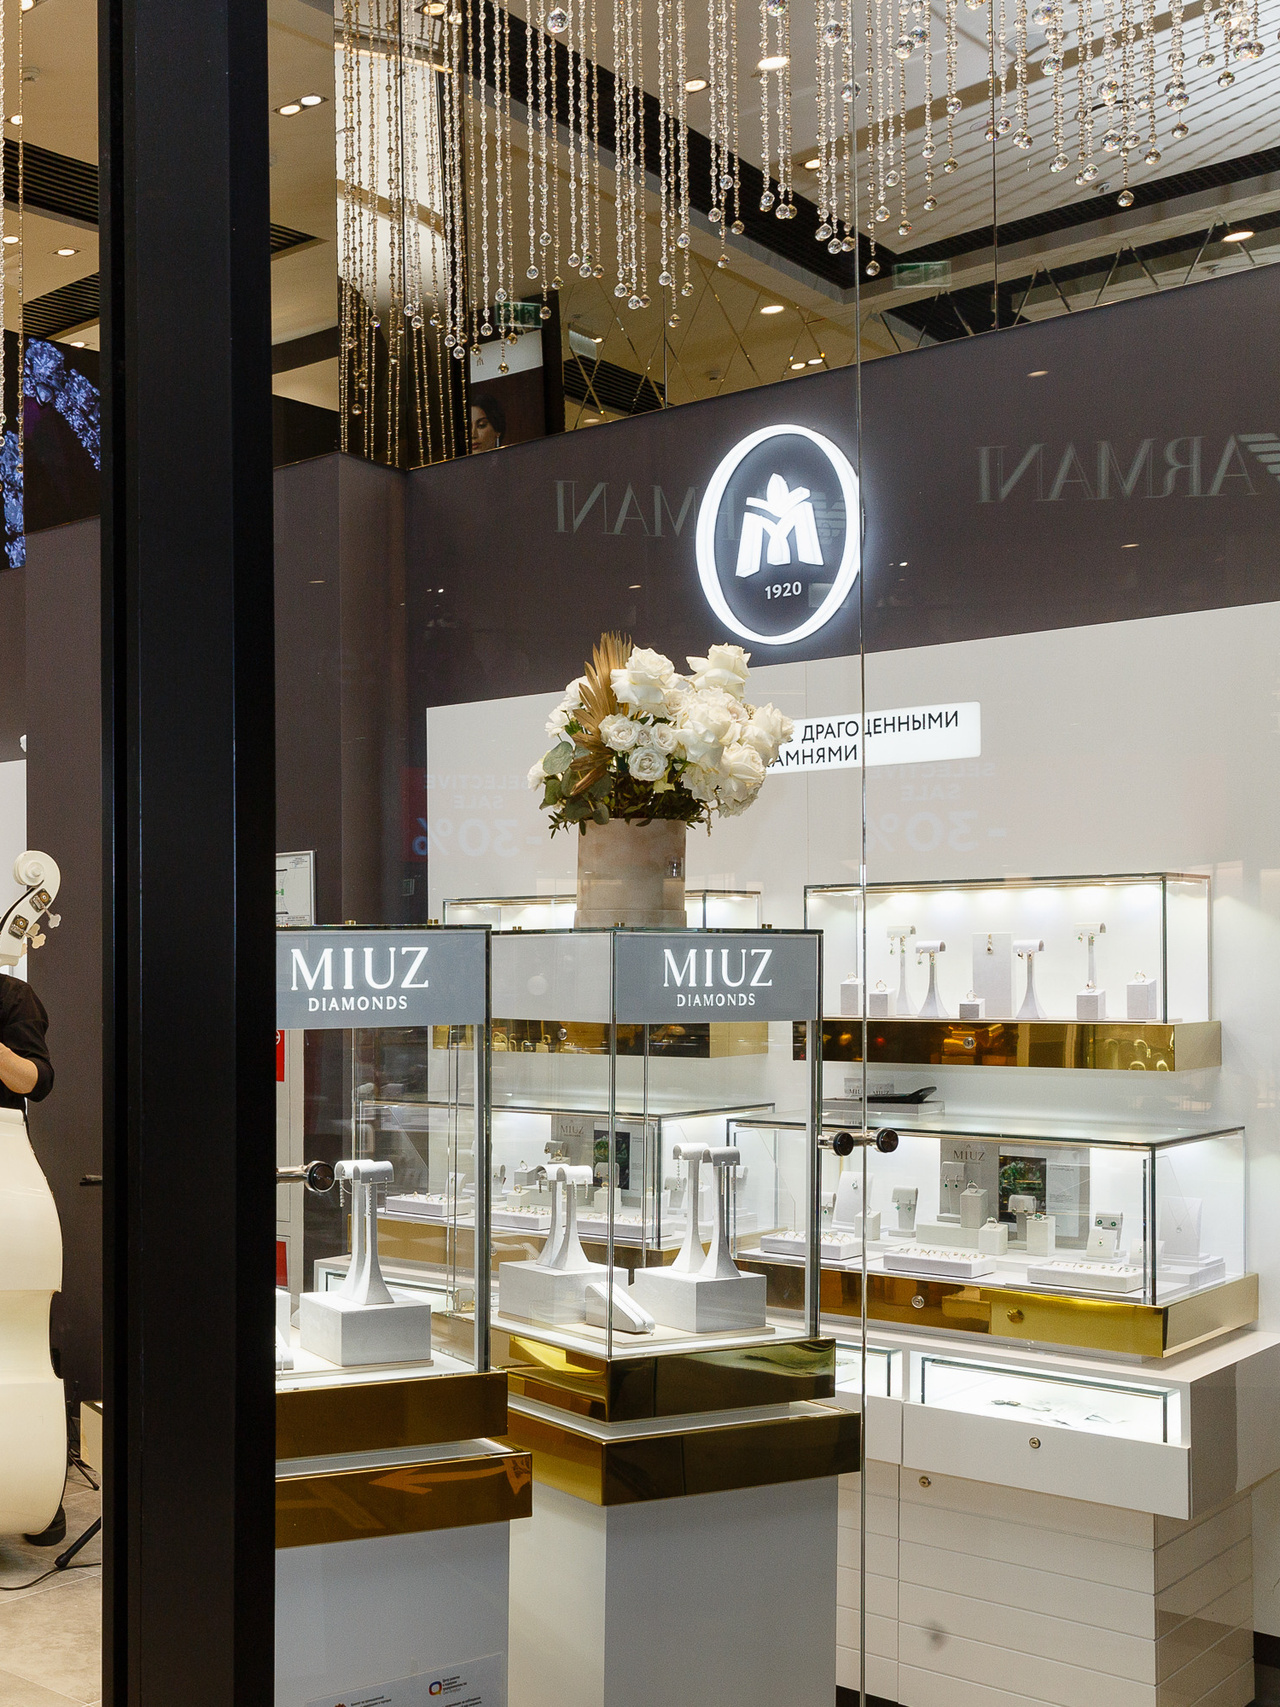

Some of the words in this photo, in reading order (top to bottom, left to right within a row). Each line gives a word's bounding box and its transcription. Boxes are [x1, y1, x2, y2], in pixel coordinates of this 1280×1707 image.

[764, 581, 802, 600] 1920
[767, 744, 858, 767] АМНЯМИ
[290, 947, 429, 991] MIUZ
[663, 949, 773, 988] MIUZ
[308, 995, 408, 1012] DIAMONDS
[677, 993, 756, 1007] DIAMONDS
[560, 1125, 584, 1135] MIUZ
[953, 1150, 985, 1162] MIUZ
